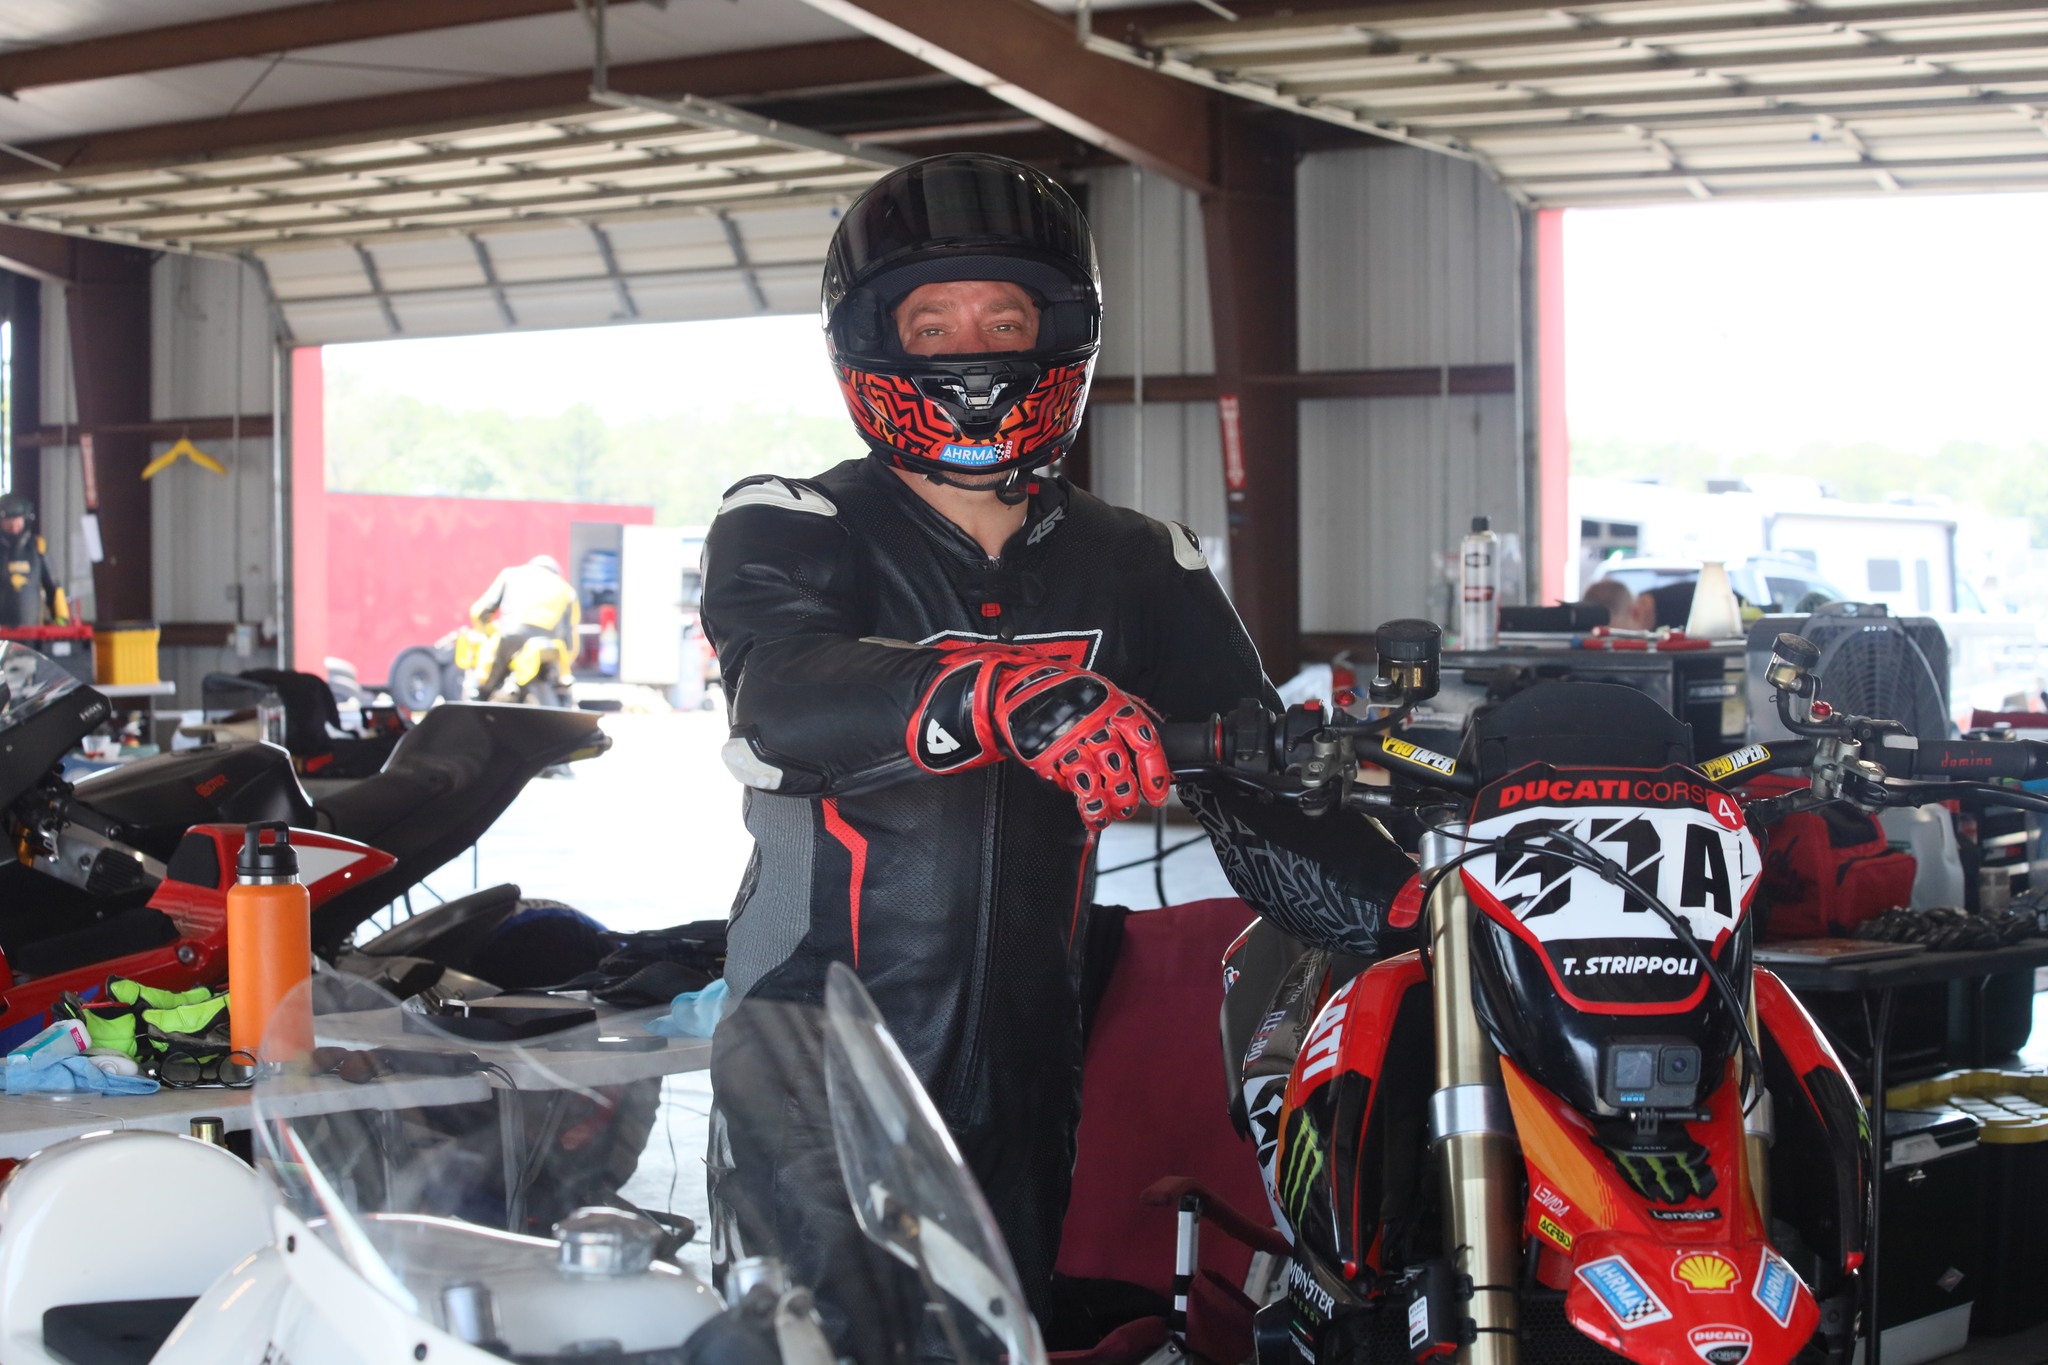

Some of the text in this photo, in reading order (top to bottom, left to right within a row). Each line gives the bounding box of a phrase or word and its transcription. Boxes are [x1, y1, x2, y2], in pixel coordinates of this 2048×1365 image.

[943, 446, 994, 462] AHRMA
[1004, 440, 1013, 459] 2025
[1941, 748, 1993, 769] domino
[1498, 780, 1630, 808] DUCATI
[1719, 798, 1738, 825] 4
[1563, 956, 1698, 976] T. STRIPPOLI
[1651, 1209, 1716, 1220] Lenovo
[1592, 1263, 1642, 1310] AHRMA
[1763, 1263, 1787, 1312] AHRMA
[1694, 1331, 1747, 1342] DUCATI
